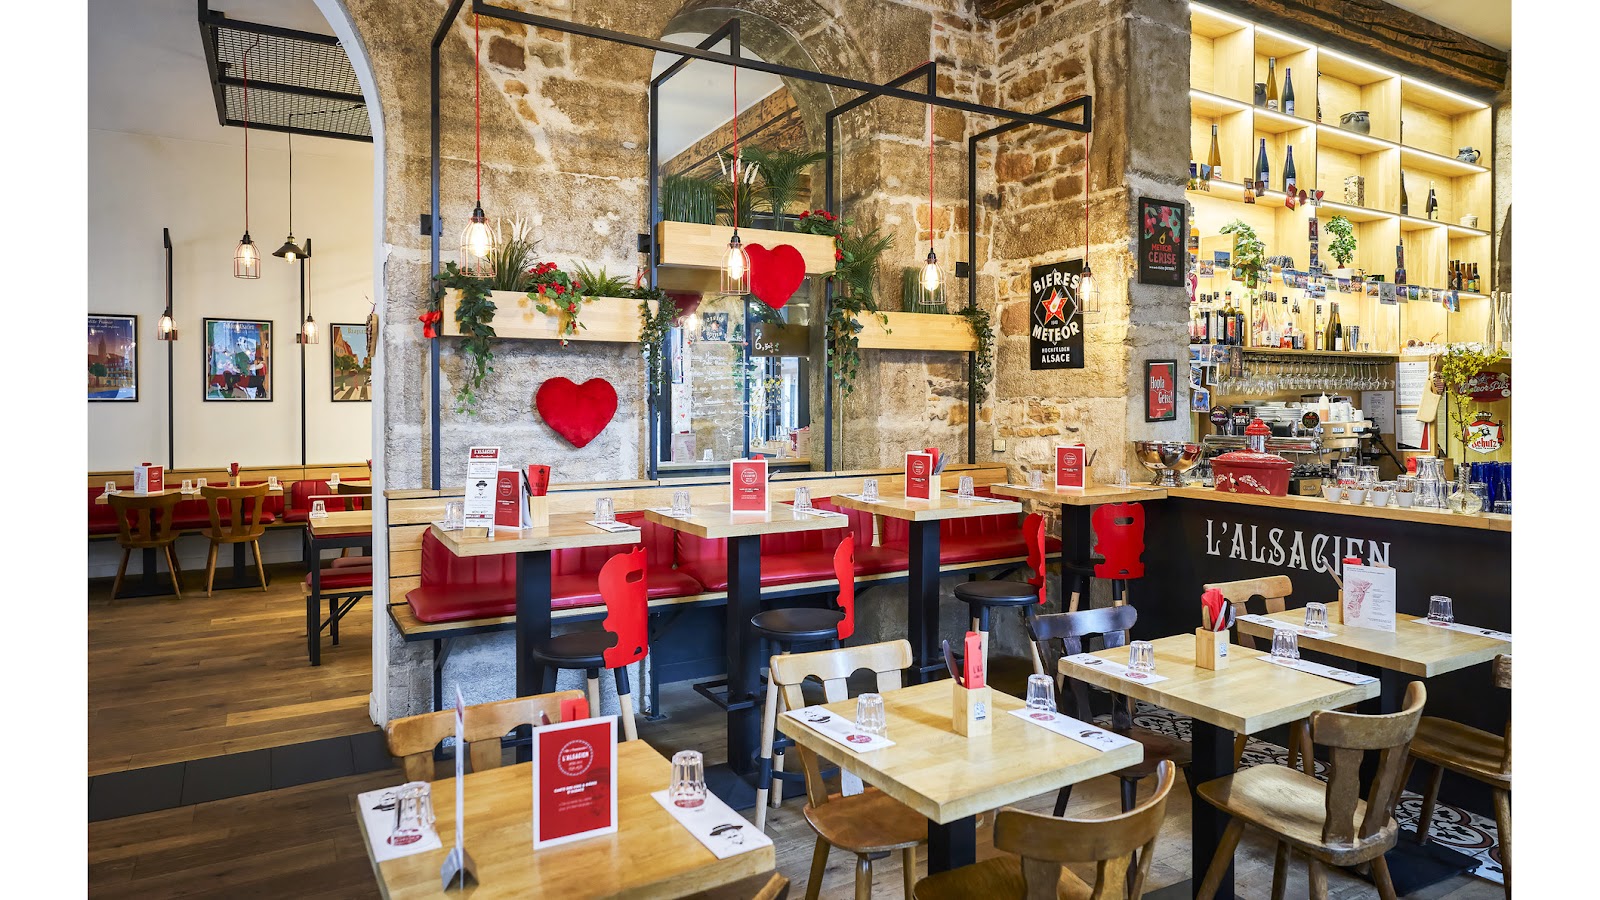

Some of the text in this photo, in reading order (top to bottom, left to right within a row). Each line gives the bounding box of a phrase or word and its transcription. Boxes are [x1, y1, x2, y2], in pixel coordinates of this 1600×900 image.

[1151, 244, 1172, 252] METEOR
[1149, 252, 1177, 265] CERISE
[1032, 271, 1081, 294] BIERES
[1032, 321, 1080, 342] METEOR
[1041, 353, 1070, 363] ALSACE
[1150, 376, 1165, 391] Hopla
[1206, 519, 1391, 576] L'ALSACIEN
